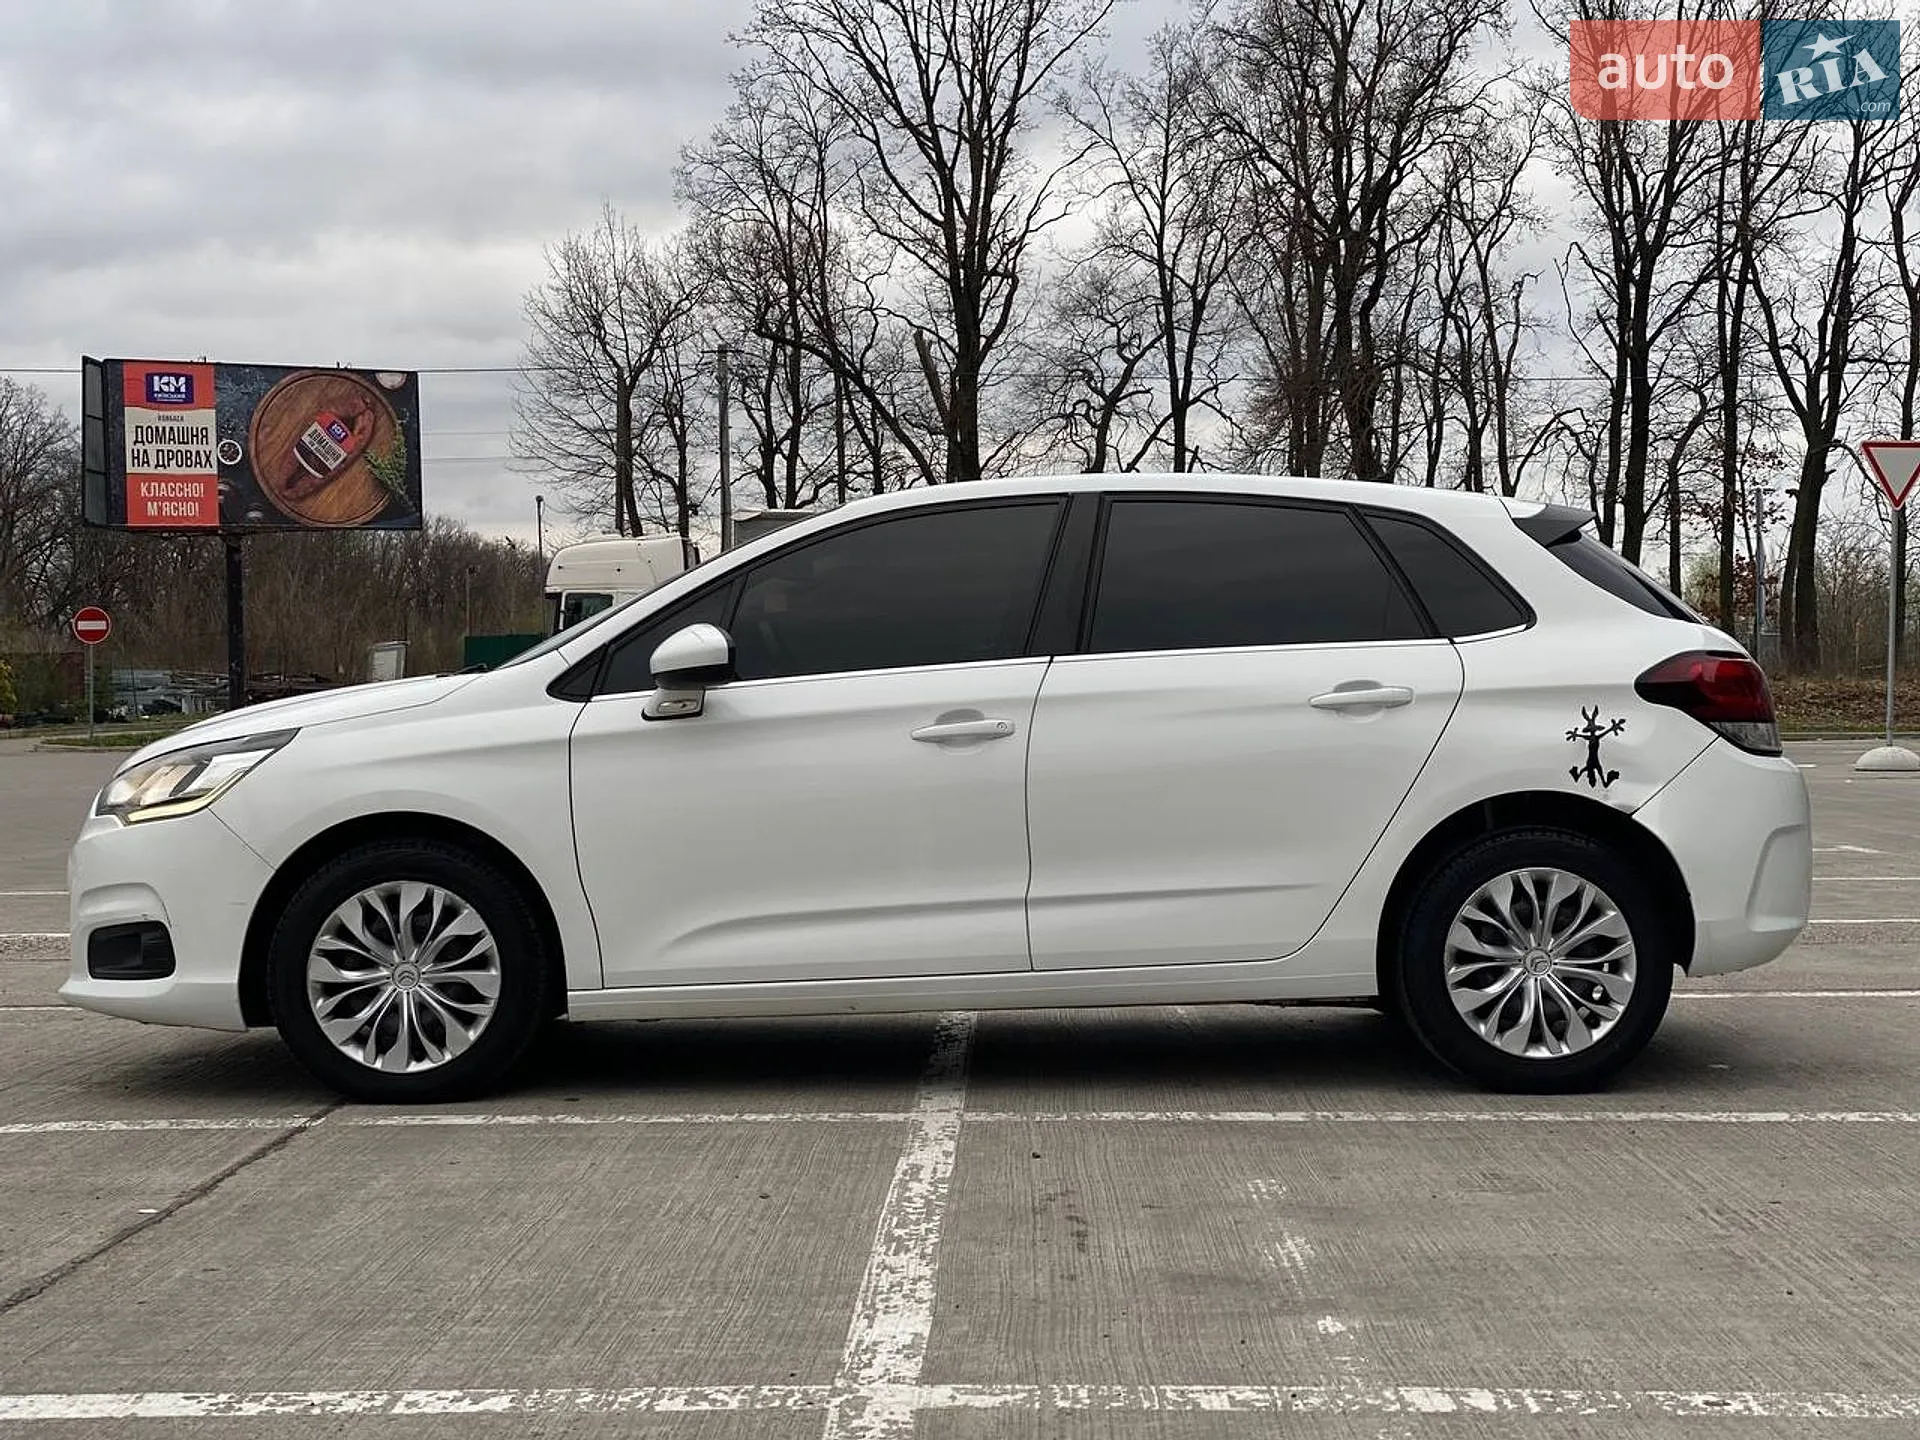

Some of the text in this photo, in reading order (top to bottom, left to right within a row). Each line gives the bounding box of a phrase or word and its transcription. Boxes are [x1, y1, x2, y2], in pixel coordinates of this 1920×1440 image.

[134, 425, 209, 446] ДОМАШНЯ
[132, 448, 212, 469] НА ДРОВАХ
[140, 481, 204, 498] КЛАССНО!
[147, 501, 199, 517] М'ЯСНО!
